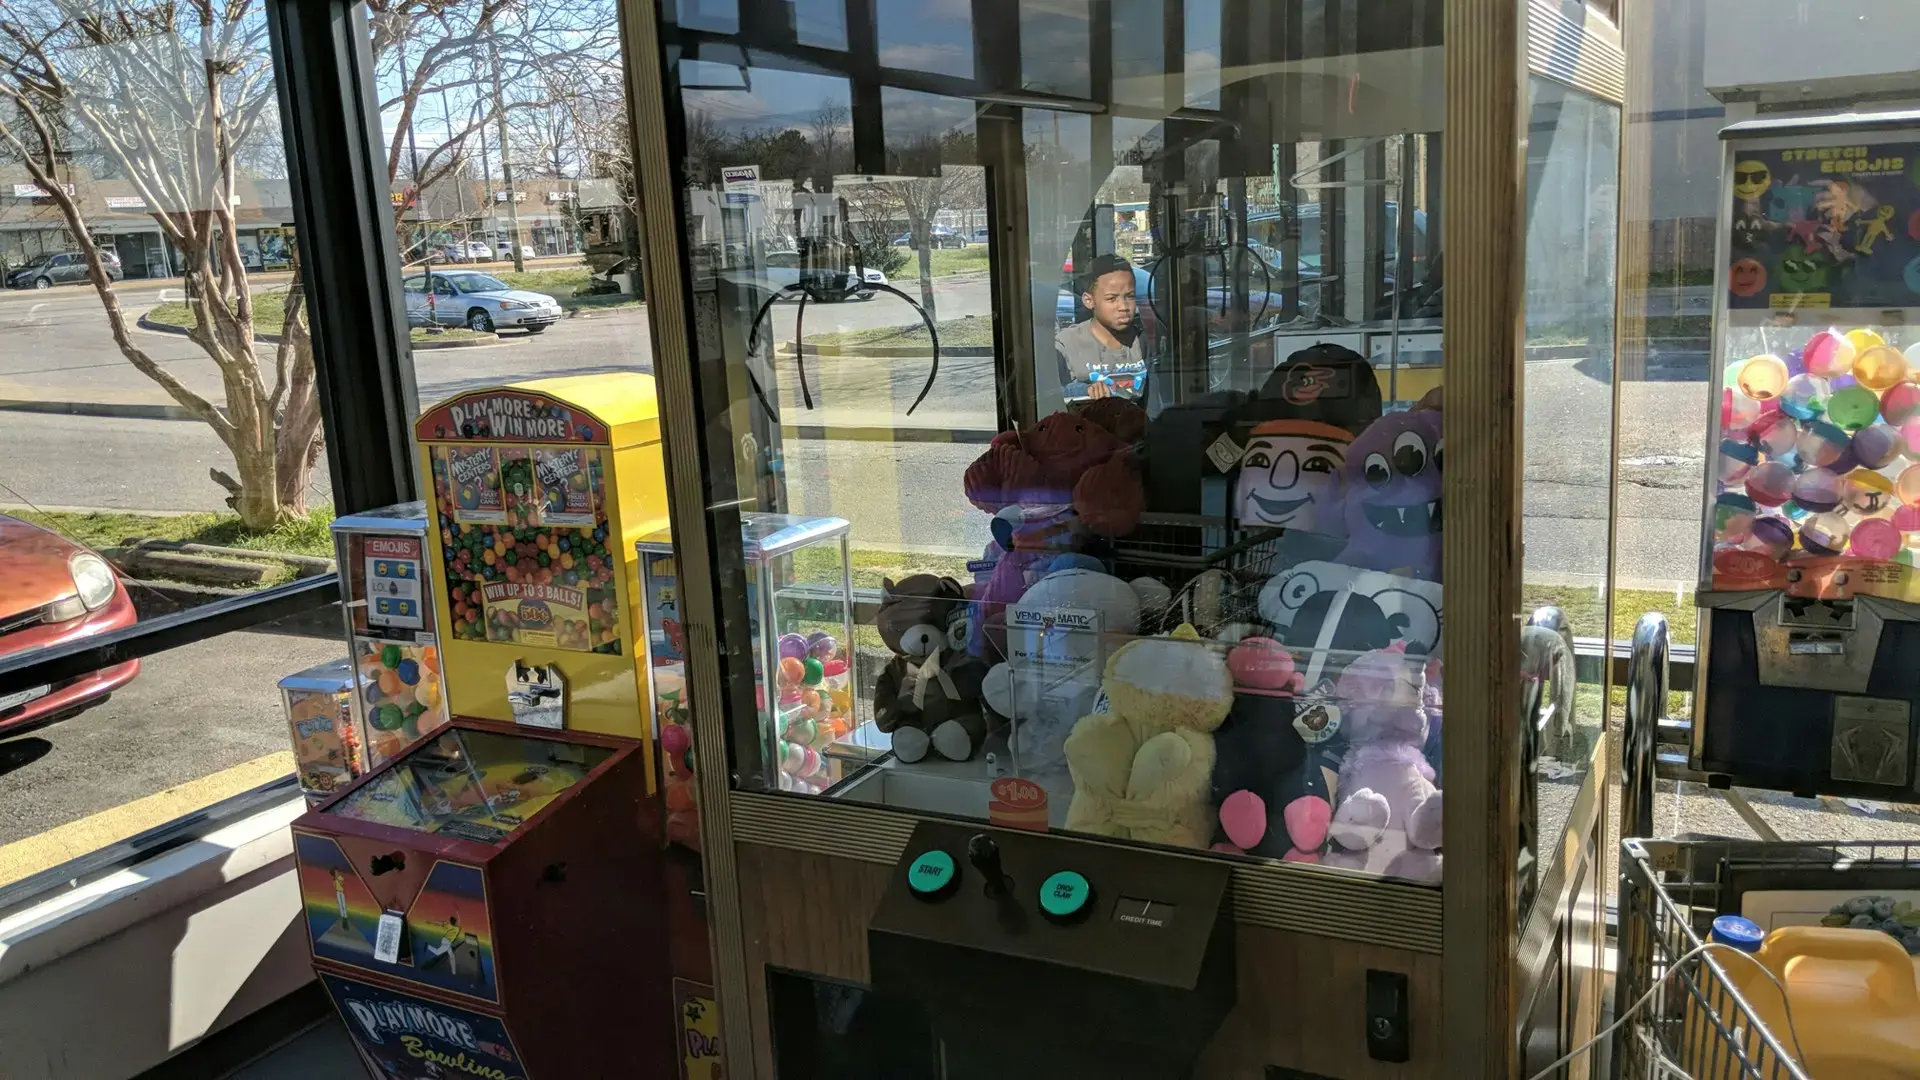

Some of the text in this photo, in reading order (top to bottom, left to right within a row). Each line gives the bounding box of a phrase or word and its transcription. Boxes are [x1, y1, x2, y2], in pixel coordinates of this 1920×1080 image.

[1781, 146, 1868, 162] STRETCH
[1820, 157, 1905, 173] EMOJIS
[451, 397, 532, 437] PLAY MORE
[487, 408, 566, 438] WIN MORE
[457, 461, 492, 483] CENTERS
[543, 463, 579, 485] CENTERS
[372, 540, 411, 554] EMOJIS
[485, 583, 582, 606] WIN UP TO 3 BALLS!
[1015, 610, 1089, 626] VEND MATIC
[1312, 720, 1338, 741] TOYS
[917, 864, 943, 877] START
[1053, 890, 1073, 900] CLAW
[1056, 882, 1075, 893] DROP
[1120, 914, 1163, 927] CREDIT TIME
